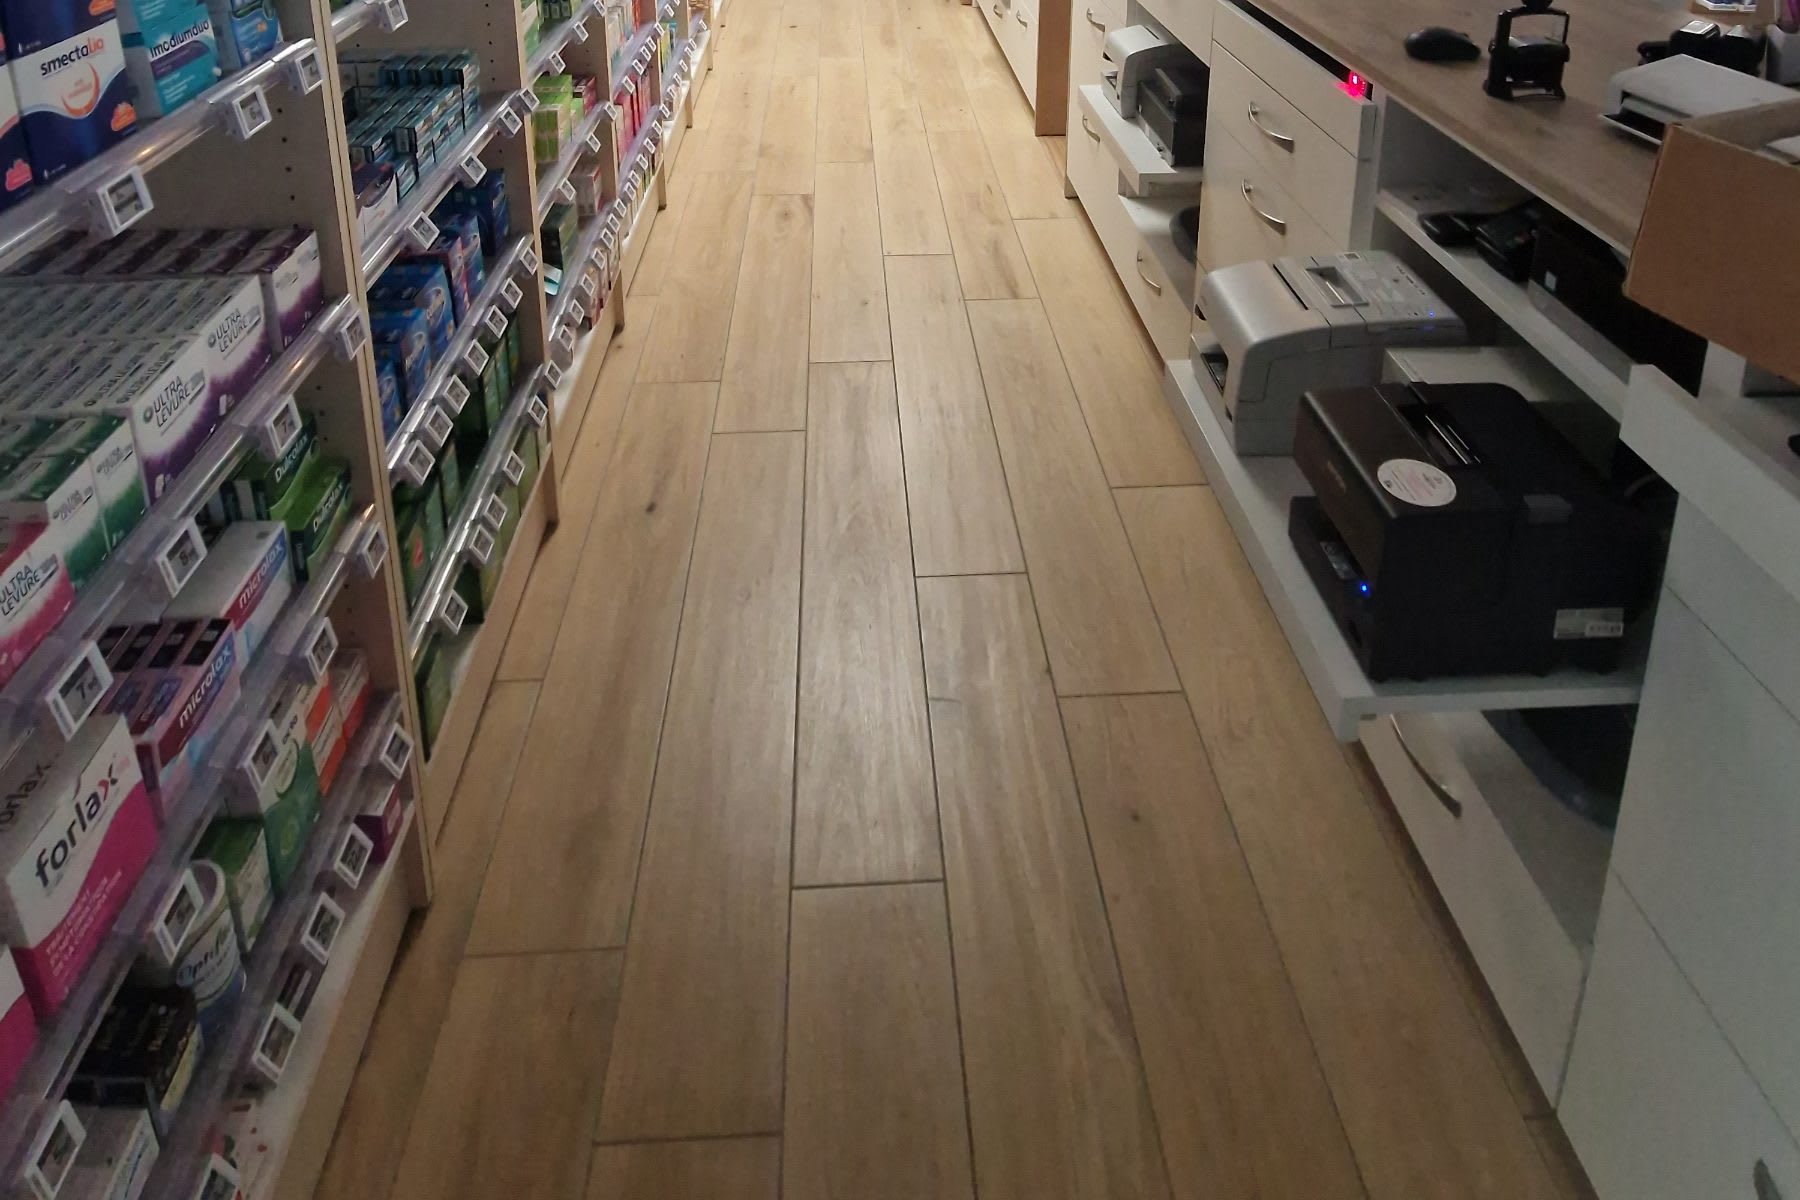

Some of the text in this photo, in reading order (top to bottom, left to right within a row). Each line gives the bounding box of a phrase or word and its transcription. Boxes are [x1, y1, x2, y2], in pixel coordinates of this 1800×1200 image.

[40, 36, 105, 76] smectalia
[150, 20, 210, 58] Imodiumduo
[215, 308, 241, 340] ULTRA
[219, 316, 248, 353] LEVURE
[153, 376, 183, 414] ULTRA
[156, 387, 191, 428] LEVURE
[1, 570, 41, 616] LEVURE
[239, 541, 285, 610] microlax
[180, 644, 233, 729] microlax
[0, 763, 52, 822] orlax
[35, 762, 119, 888] forlax
